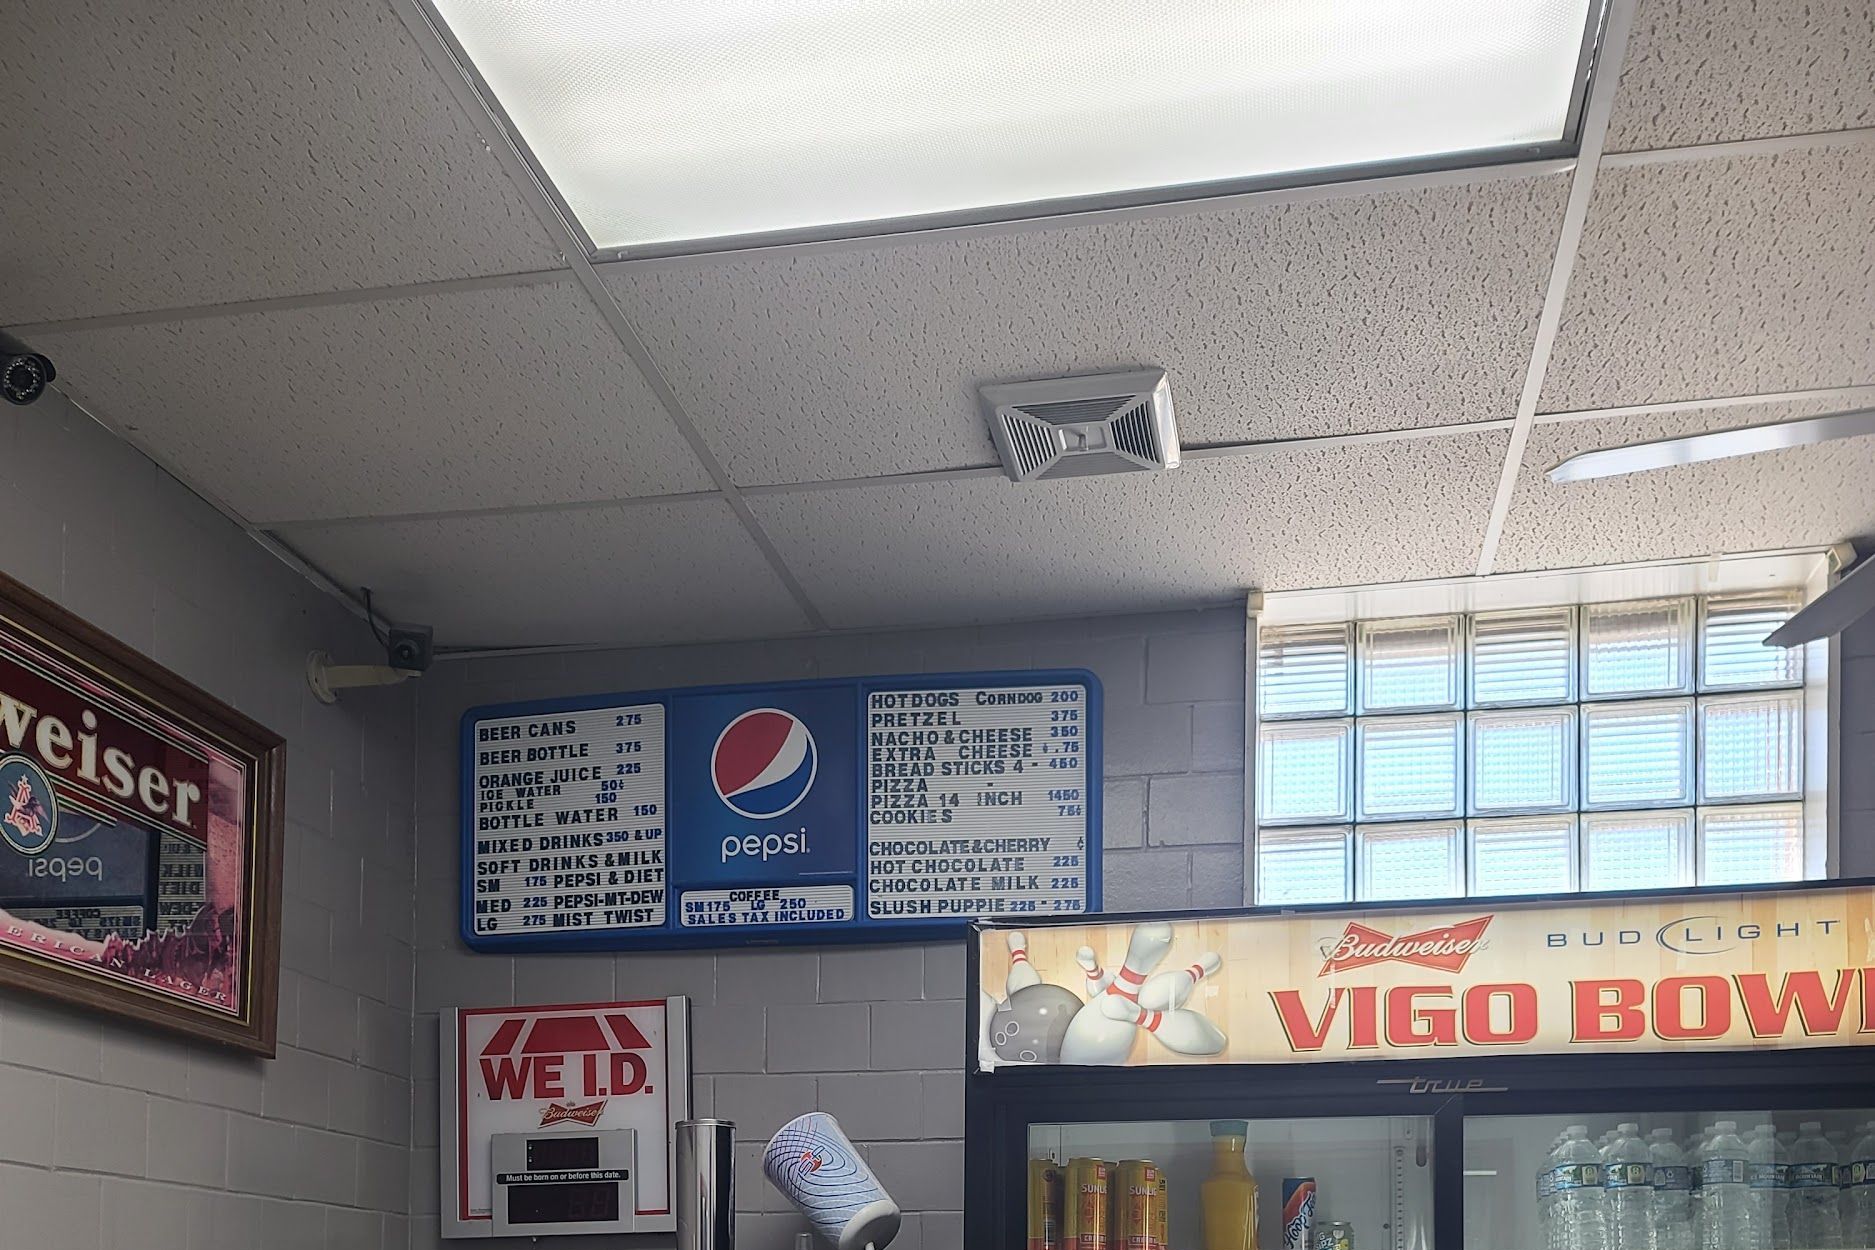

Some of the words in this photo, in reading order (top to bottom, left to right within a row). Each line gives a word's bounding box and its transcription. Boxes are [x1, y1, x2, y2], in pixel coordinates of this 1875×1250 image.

[1051, 691, 1078, 702] 200
[479, 726, 521, 742] BEER
[528, 721, 576, 737] CANS
[616, 714, 641, 726] 275
[872, 712, 961, 727] PRETZEL
[1051, 710, 1078, 721] 375
[872, 731, 938, 746] NACHO
[959, 728, 1032, 743] CHEESE
[0, 694, 200, 827] weiser
[480, 749, 521, 765] BEER
[527, 744, 589, 761] BOTTLE
[616, 742, 641, 753] 375
[872, 747, 935, 762] EXTRA
[959, 743, 1032, 759] CHEESE
[479, 772, 544, 788] ORANGE
[551, 767, 601, 783] JUICE
[617, 763, 641, 775] 225
[873, 763, 934, 777] BREAD
[942, 760, 1005, 775] STICKS
[1013, 760, 1023, 773] 4
[516, 785, 561, 797] WATER
[872, 779, 928, 793] PIZZA
[480, 800, 534, 812] PICKLE
[595, 793, 616, 803] 150
[872, 795, 928, 808] PIZZA
[940, 793, 959, 806] 14
[977, 792, 1022, 806] INCH
[480, 813, 544, 830] BOTTLE
[556, 807, 618, 825] WATER
[634, 805, 656, 816] 150
[870, 809, 952, 824] COOKIES
[478, 838, 532, 854] MIXED
[540, 833, 603, 850] DRINKS
[606, 831, 628, 842] 350
[646, 828, 662, 839] UP
[722, 827, 806, 862] pepsi
[478, 860, 520, 875] SOFT
[529, 855, 598, 871] DRINKS
[871, 860, 905, 874] HOT
[912, 858, 1024, 873] CHOCOLATE
[1053, 856, 1078, 867] 225
[477, 879, 500, 893] SM
[524, 876, 546, 886] 175
[554, 873, 600, 888] PEPSI
[608, 872, 618, 885] &
[624, 868, 664, 883] DIET
[870, 877, 980, 893] CHOCOLATE
[991, 876, 1039, 891] MILK
[1051, 878, 1078, 888] 225
[477, 899, 511, 913] MED
[524, 897, 547, 908] 225
[730, 890, 779, 902] COFFEE
[751, 900, 765, 910] LG
[780, 899, 806, 910] 250
[688, 913, 736, 924] SALES
[742, 912, 769, 922] TAX
[775, 909, 844, 921] INCLUDED
[870, 900, 931, 915] SLUSH
[938, 899, 1005, 913] PUPPIE
[478, 918, 497, 931] LG
[523, 915, 546, 926] 275
[553, 912, 593, 927] MIST
[604, 909, 654, 924] TWIST
[1547, 930, 1641, 948] BUD
[1685, 920, 1840, 942] LIGHT
[1317, 932, 1489, 961] Budweiser
[7, 926, 125, 969] ERICAN
[144, 969, 226, 1001] LAGER
[1267, 980, 1539, 1053] VIGO
[1568, 968, 1875, 1045] BOW
[480, 1055, 564, 1100] WE
[584, 1053, 653, 1096] I.D.
[538, 1103, 605, 1119] Budweiser
